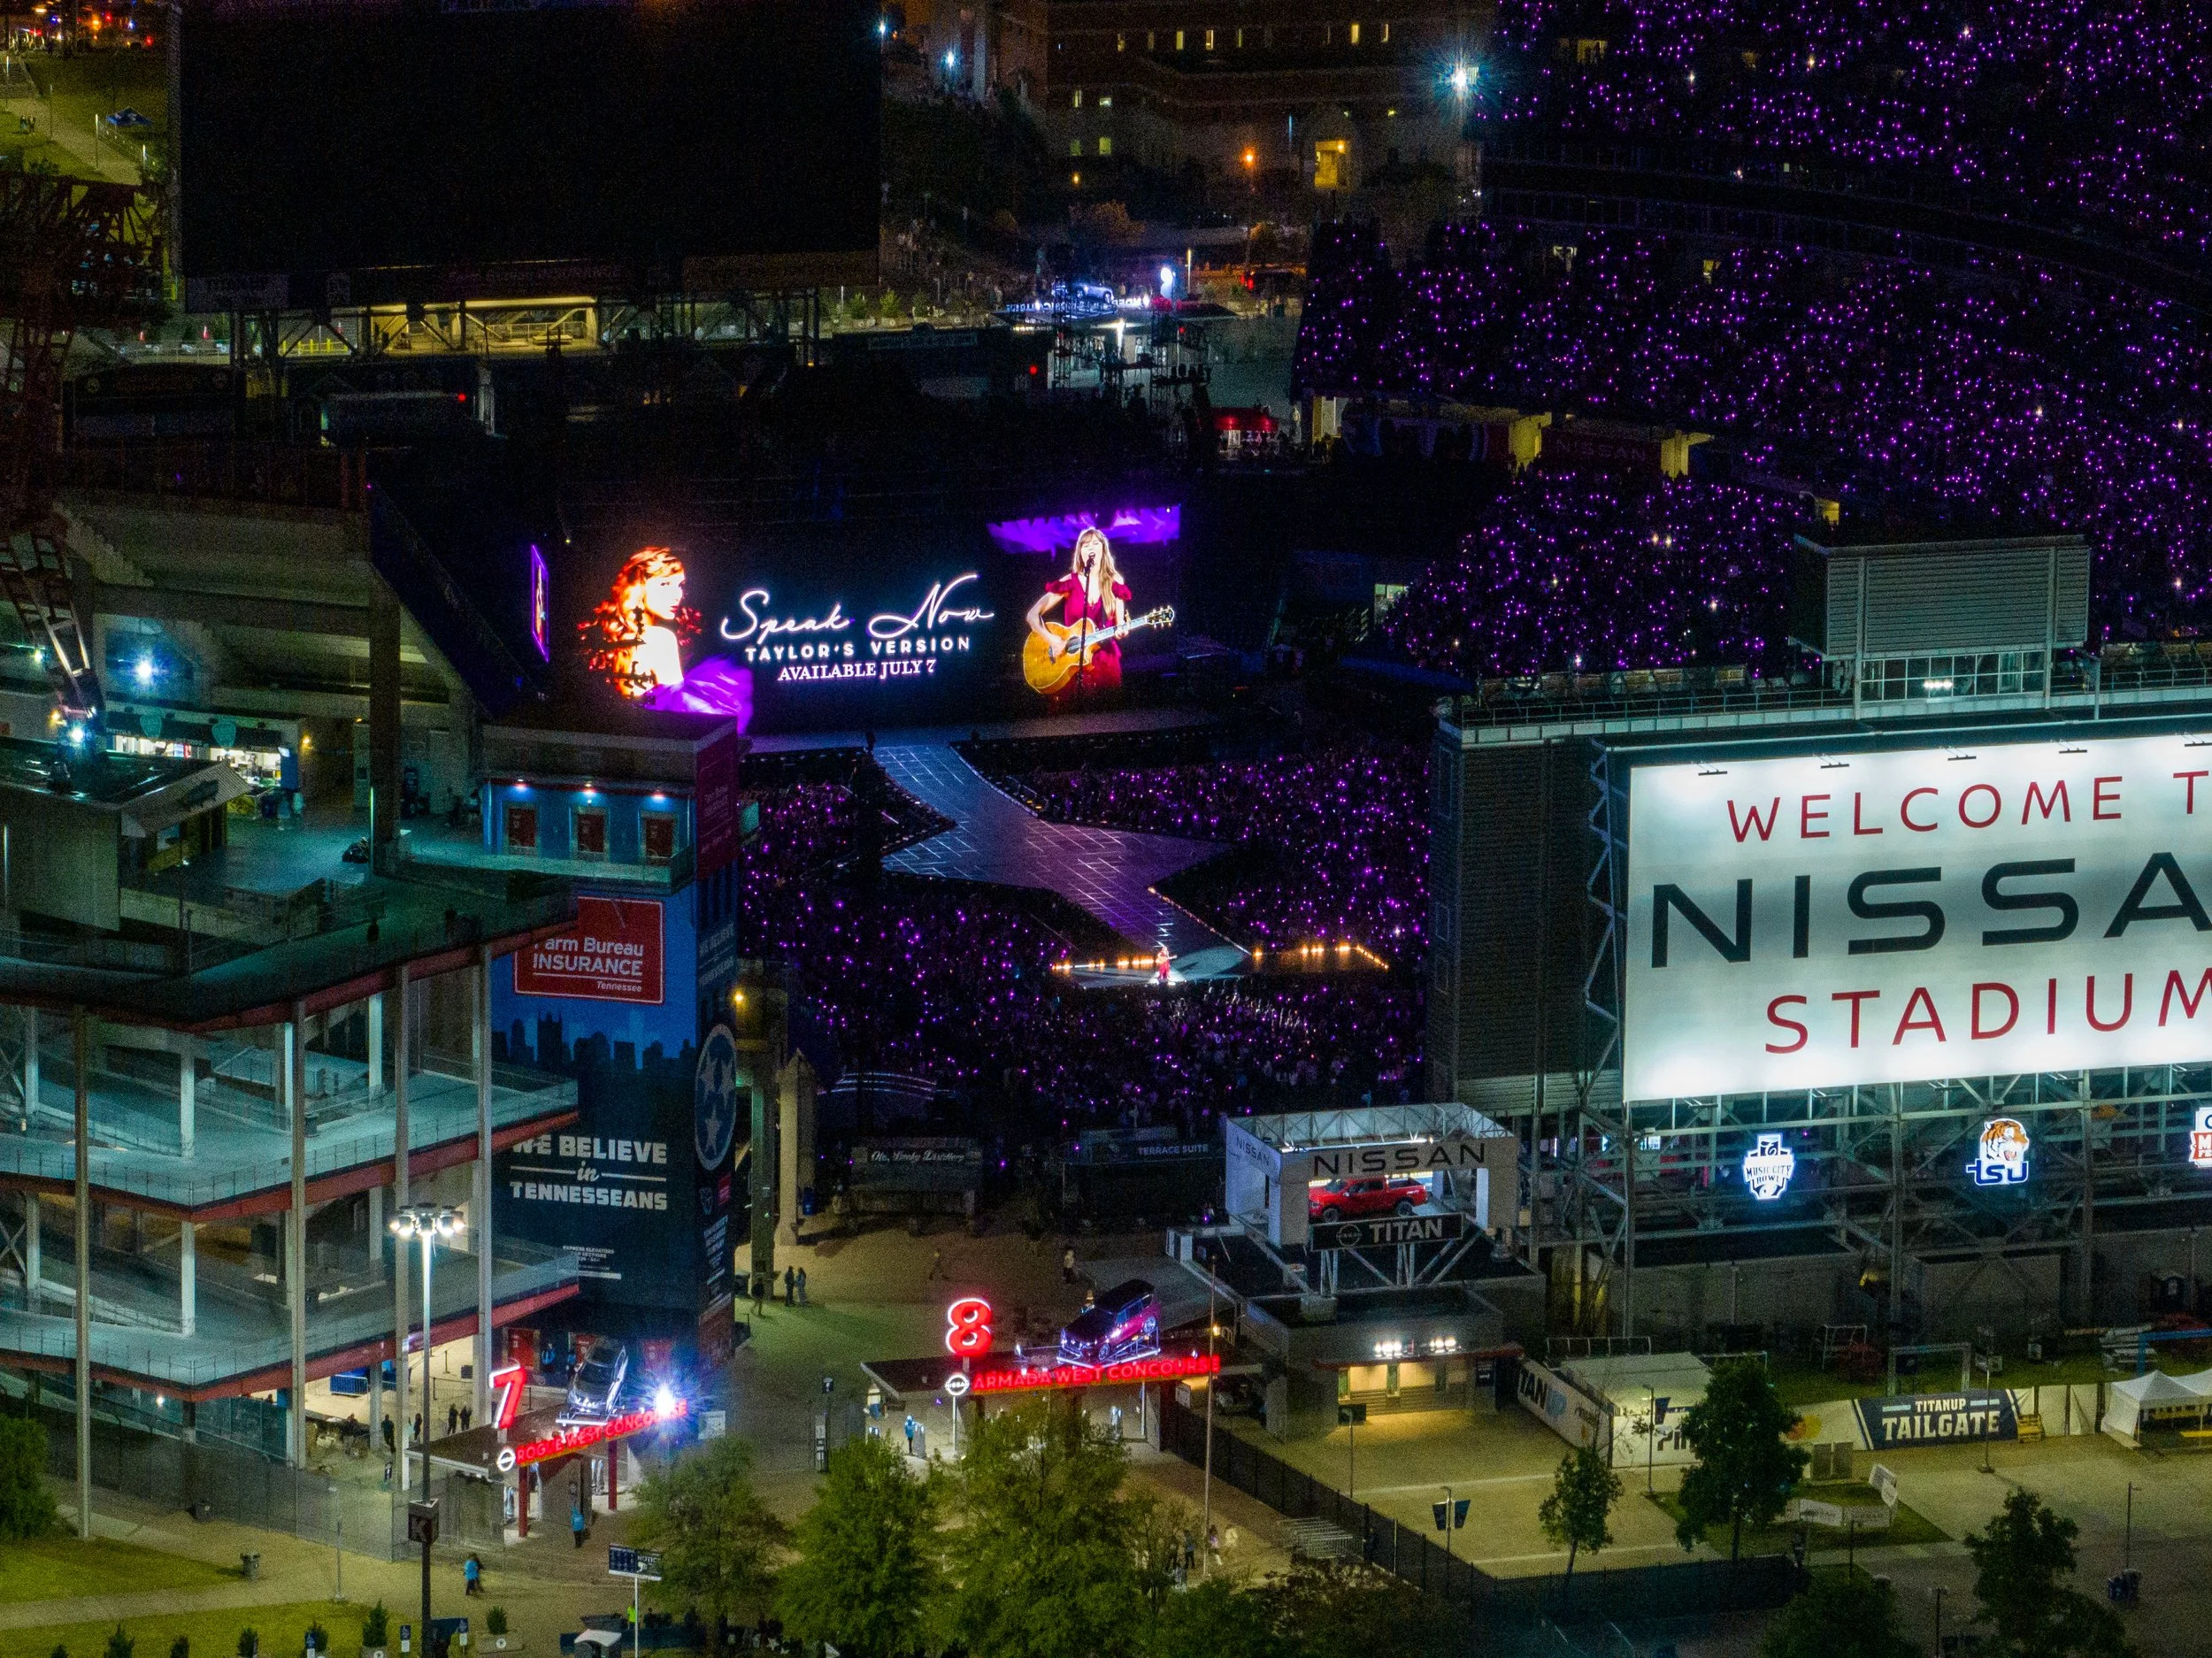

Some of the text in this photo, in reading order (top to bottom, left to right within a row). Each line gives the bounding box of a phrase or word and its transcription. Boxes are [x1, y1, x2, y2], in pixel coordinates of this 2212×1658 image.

[720, 573, 995, 644] Speak Now
[745, 636, 970, 662] TAYLOR'S VERSION
[778, 658, 936, 681] AVAILABLE JULY 7
[1726, 776, 2123, 843] WELCOME
[534, 936, 644, 957] arm Bureau
[533, 952, 644, 977] INSURANCE
[596, 979, 643, 993] Tennessee
[1765, 966, 2212, 1054] STADIUM
[558, 1134, 667, 1164] BELIEVE
[1138, 1143, 1209, 1155] TERRACE SUITE
[1313, 1142, 1486, 1177] NISSAN
[577, 1160, 600, 1182] in
[1746, 1164, 1792, 1178] MUSIC CITY
[1756, 1175, 1779, 1185] BOWL
[510, 1180, 668, 1210] TENNESSEANS
[1369, 1217, 1442, 1243] TITAN
[946, 1297, 992, 1356] 8
[973, 1369, 1051, 1390] ARMADA
[1053, 1363, 1103, 1383] WEST
[488, 1363, 527, 1430] 7
[1881, 1410, 2001, 1441] TAILGATE
[516, 1437, 565, 1462] ROGUE
[565, 1426, 603, 1447] WEST
[411, 1516, 427, 1543] K
